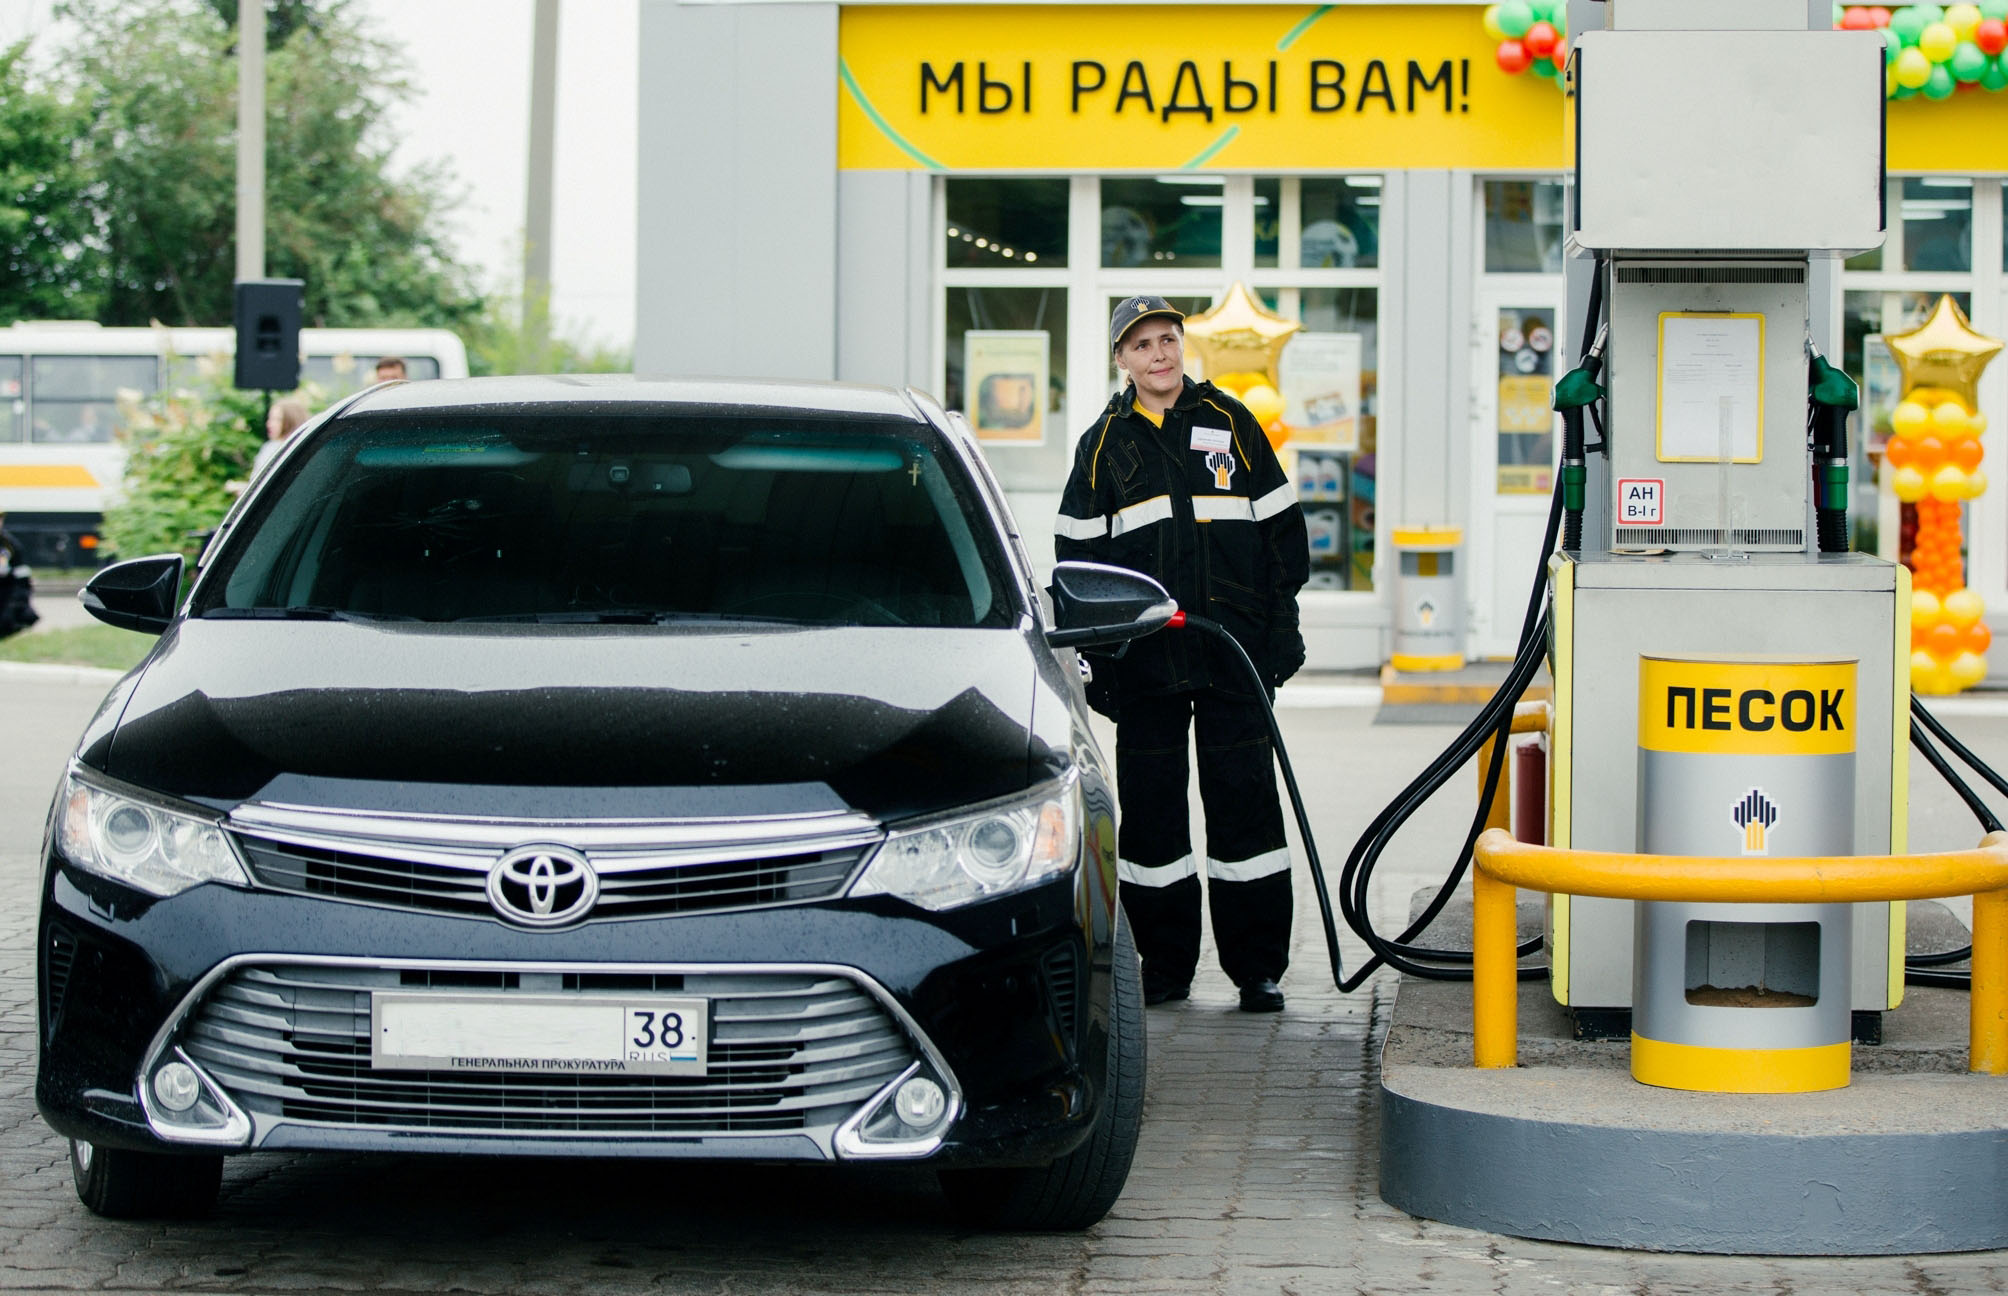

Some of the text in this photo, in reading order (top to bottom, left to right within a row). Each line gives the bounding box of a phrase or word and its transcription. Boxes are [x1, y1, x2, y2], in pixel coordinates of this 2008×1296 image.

[919, 59, 1472, 123] МЫ РАДЫ ВАМ!
[1667, 686, 1845, 732] ПЕСОК
[633, 1011, 684, 1049] 38
[451, 1056, 626, 1071] ГЕНЕРАЛЬНАЯ ПРОКУРАТУРА
